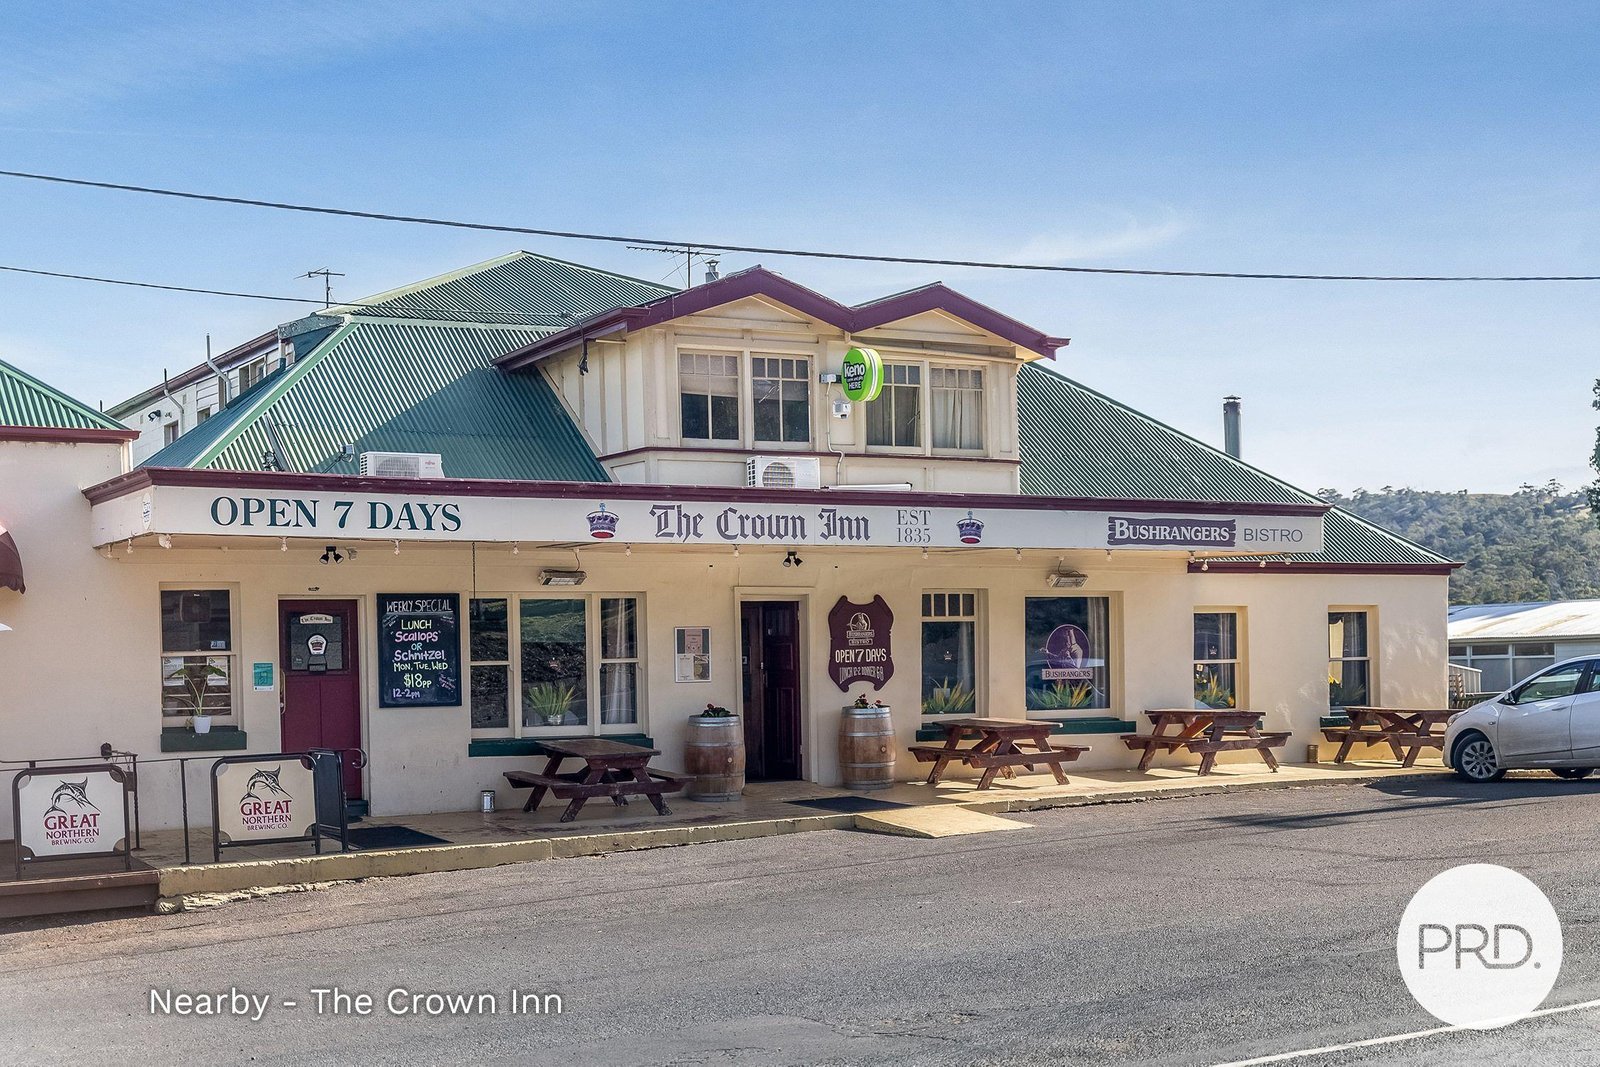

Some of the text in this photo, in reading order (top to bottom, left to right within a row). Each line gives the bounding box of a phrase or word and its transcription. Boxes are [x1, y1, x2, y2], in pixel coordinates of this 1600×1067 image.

[844, 362, 865, 378] keno
[848, 382, 861, 390] HERE
[210, 496, 462, 532] OPEN 7 DAYS
[896, 509, 932, 526] EST
[649, 504, 870, 542] The Crown Inn
[1114, 519, 1303, 542] BUSHRANGERS BISTRO
[896, 528, 932, 544] 1835
[386, 599, 452, 612] WEEKLY SPECIAL
[401, 620, 432, 630] LUNCH
[411, 642, 422, 650] OR
[836, 648, 887, 663] OPEN 7 DAYS
[431, 661, 448, 670] WED
[240, 800, 292, 816] GREAT
[44, 814, 100, 830] GREAT
[242, 814, 292, 825] NORTHERN
[46, 828, 100, 839] NORTHERN
